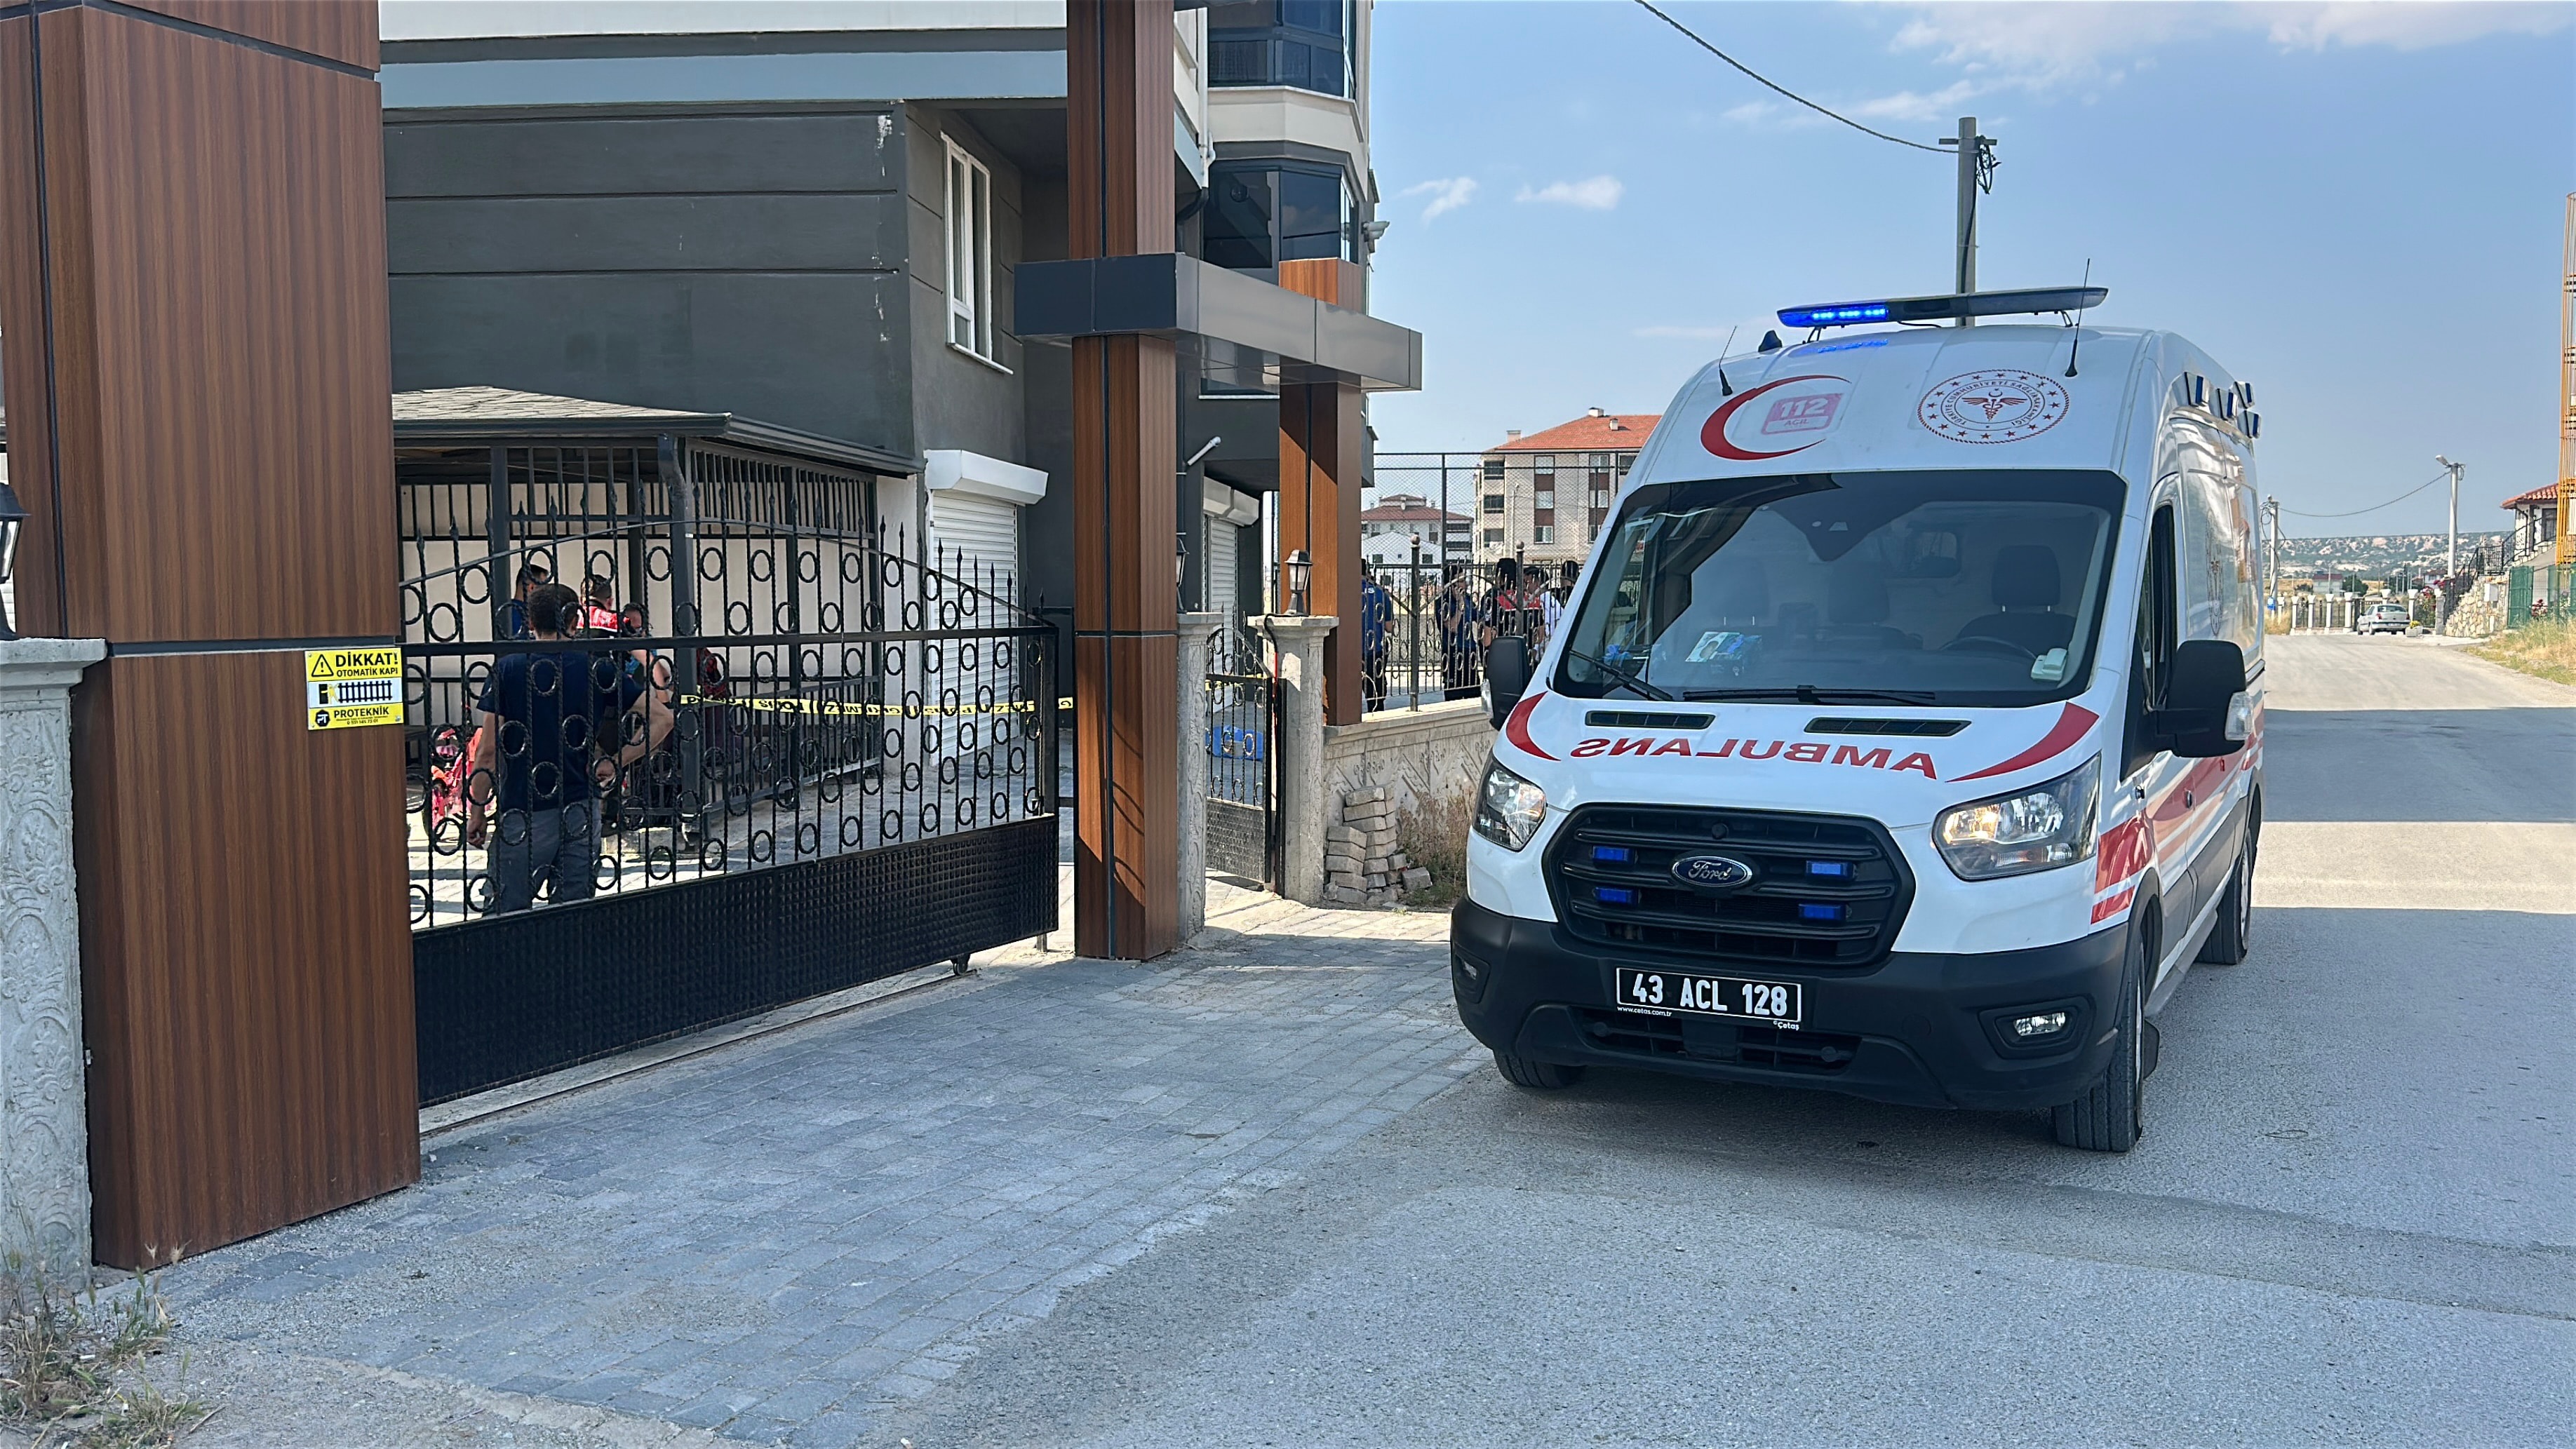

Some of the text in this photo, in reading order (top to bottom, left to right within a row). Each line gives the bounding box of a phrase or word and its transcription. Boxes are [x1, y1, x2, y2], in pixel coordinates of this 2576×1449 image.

[1780, 398, 1828, 417] 112
[335, 652, 398, 667] DİKKAT!
[337, 667, 377, 677] OTOMATİK
[334, 706, 389, 718] PROTEKNİK
[1688, 861, 1732, 880] Ford
[1633, 973, 1787, 1016] 43 ACL 128
